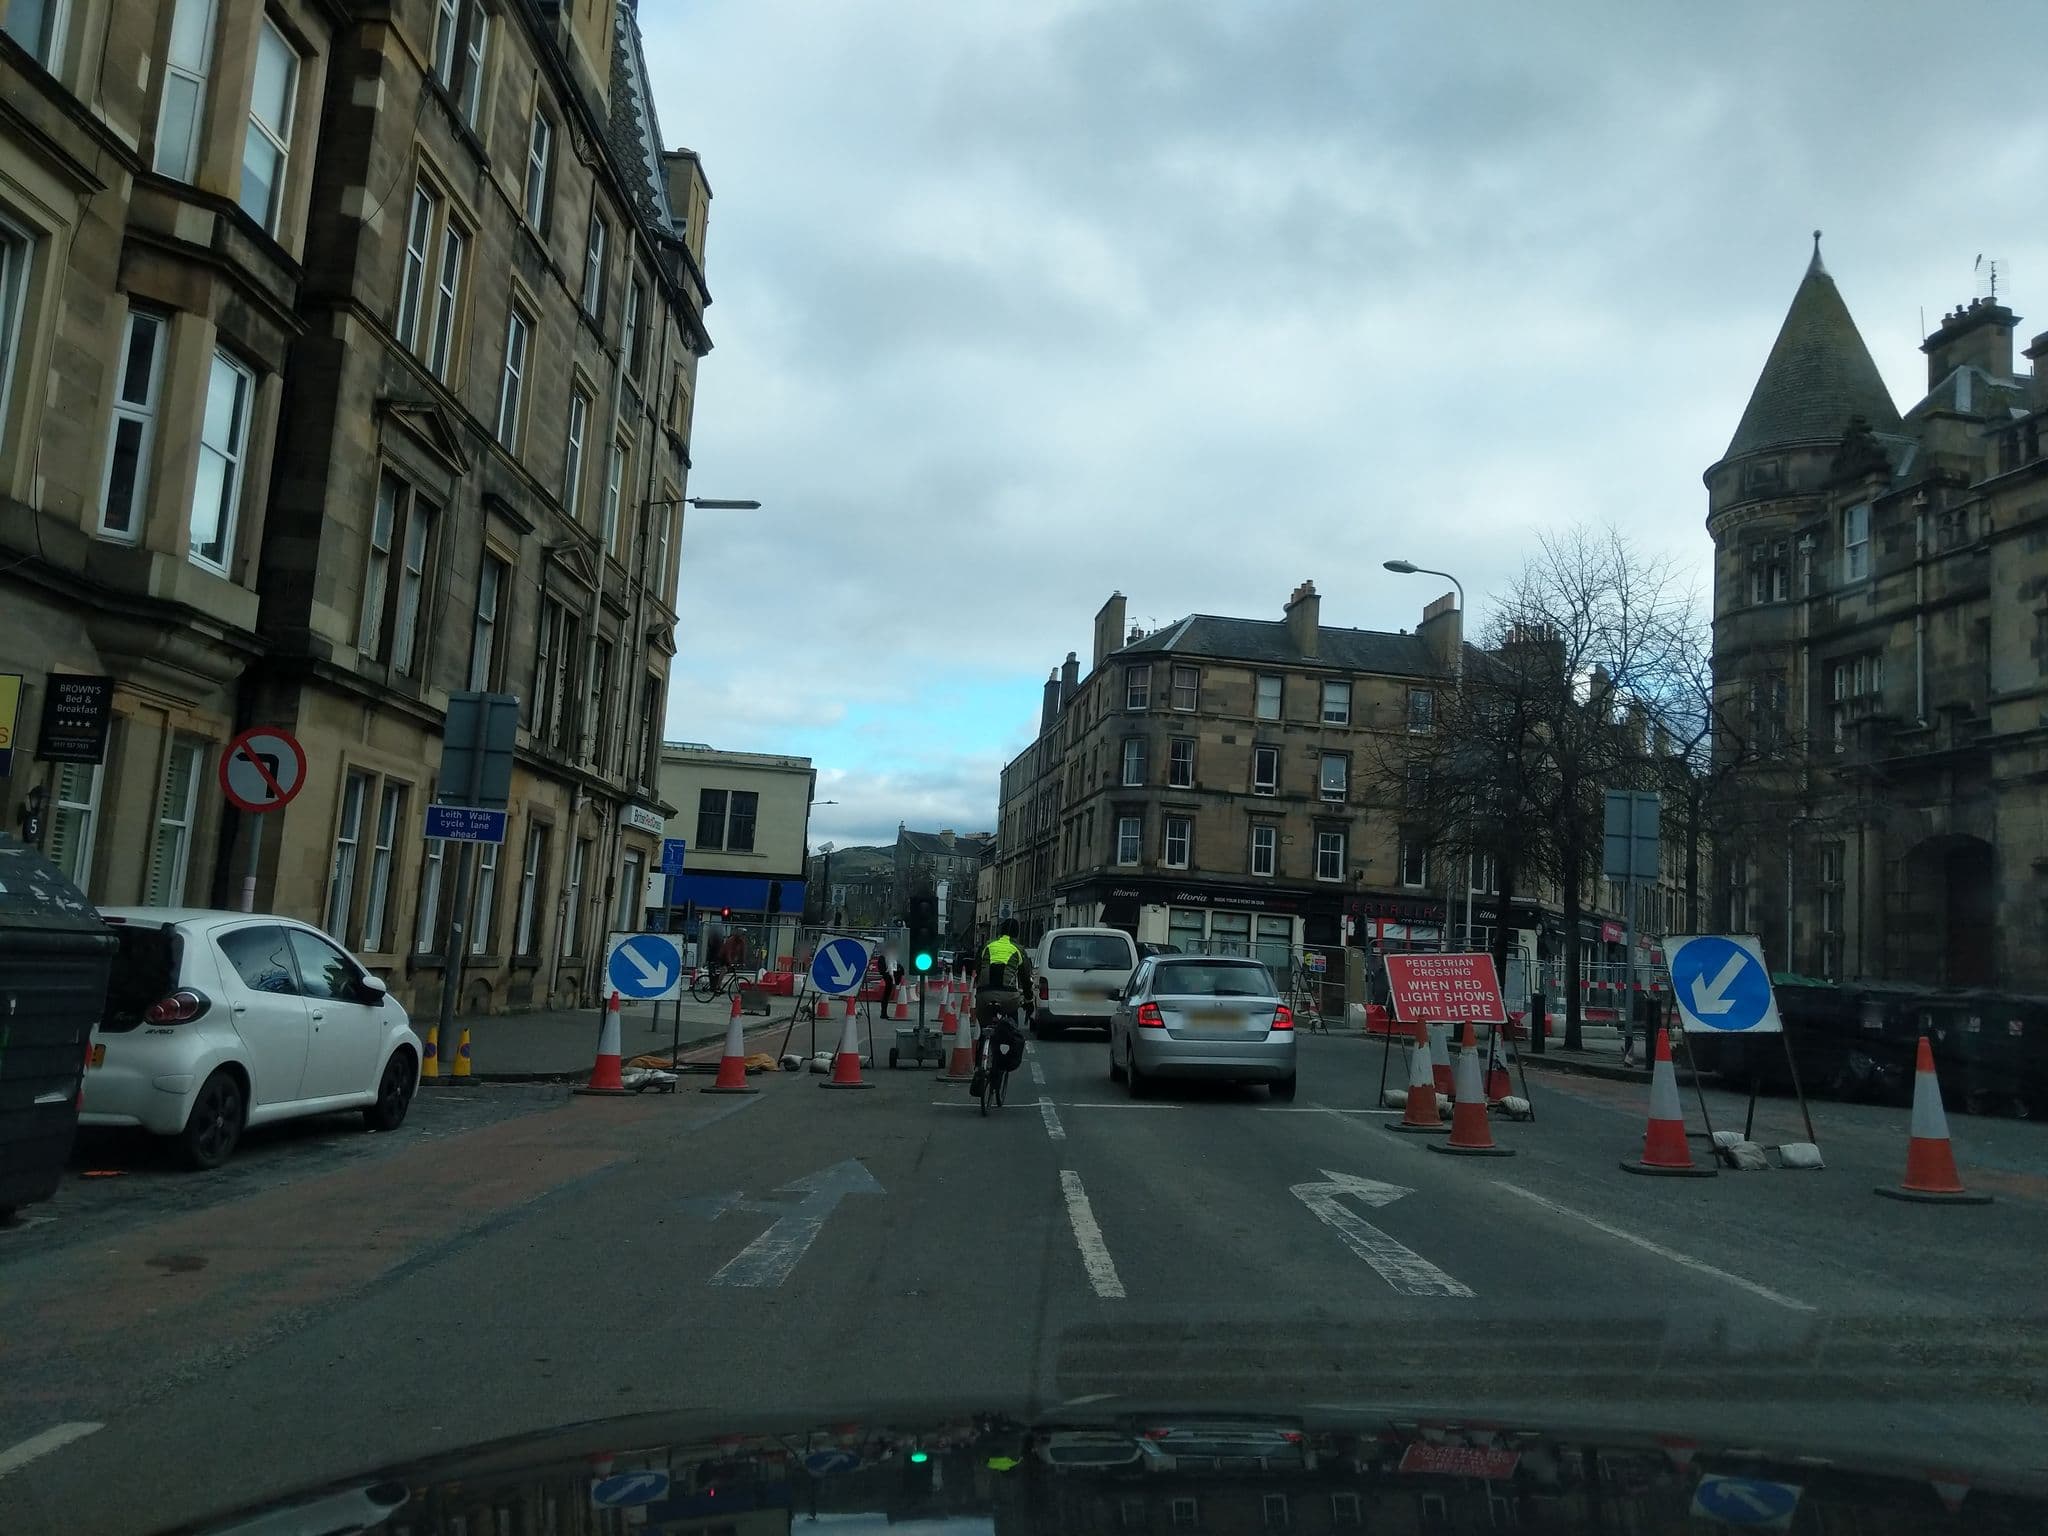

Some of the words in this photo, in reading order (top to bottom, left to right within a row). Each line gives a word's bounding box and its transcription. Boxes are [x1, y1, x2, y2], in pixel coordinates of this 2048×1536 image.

[59, 684, 102, 695] BROWN'S
[65, 694, 82, 703] Bed
[85, 695, 92, 703] &
[56, 704, 97, 714] Breakfast
[439, 809, 463, 819] Leith
[469, 811, 492, 821] Walk
[30, 819, 38, 834] 5
[440, 820, 465, 828] cycle
[470, 820, 490, 830] lane
[450, 830, 477, 838] ahead
[1405, 959, 1474, 968] PEDESTRIAN
[1412, 968, 1471, 977] CROSSING
[1407, 980, 1450, 991] WHEN
[1454, 980, 1482, 990] RED
[1400, 992, 1440, 1002] LIGHT
[1444, 991, 1495, 1002] SHOWS
[1408, 1006, 1442, 1017] WAIT
[1446, 1004, 1493, 1017] HERE
